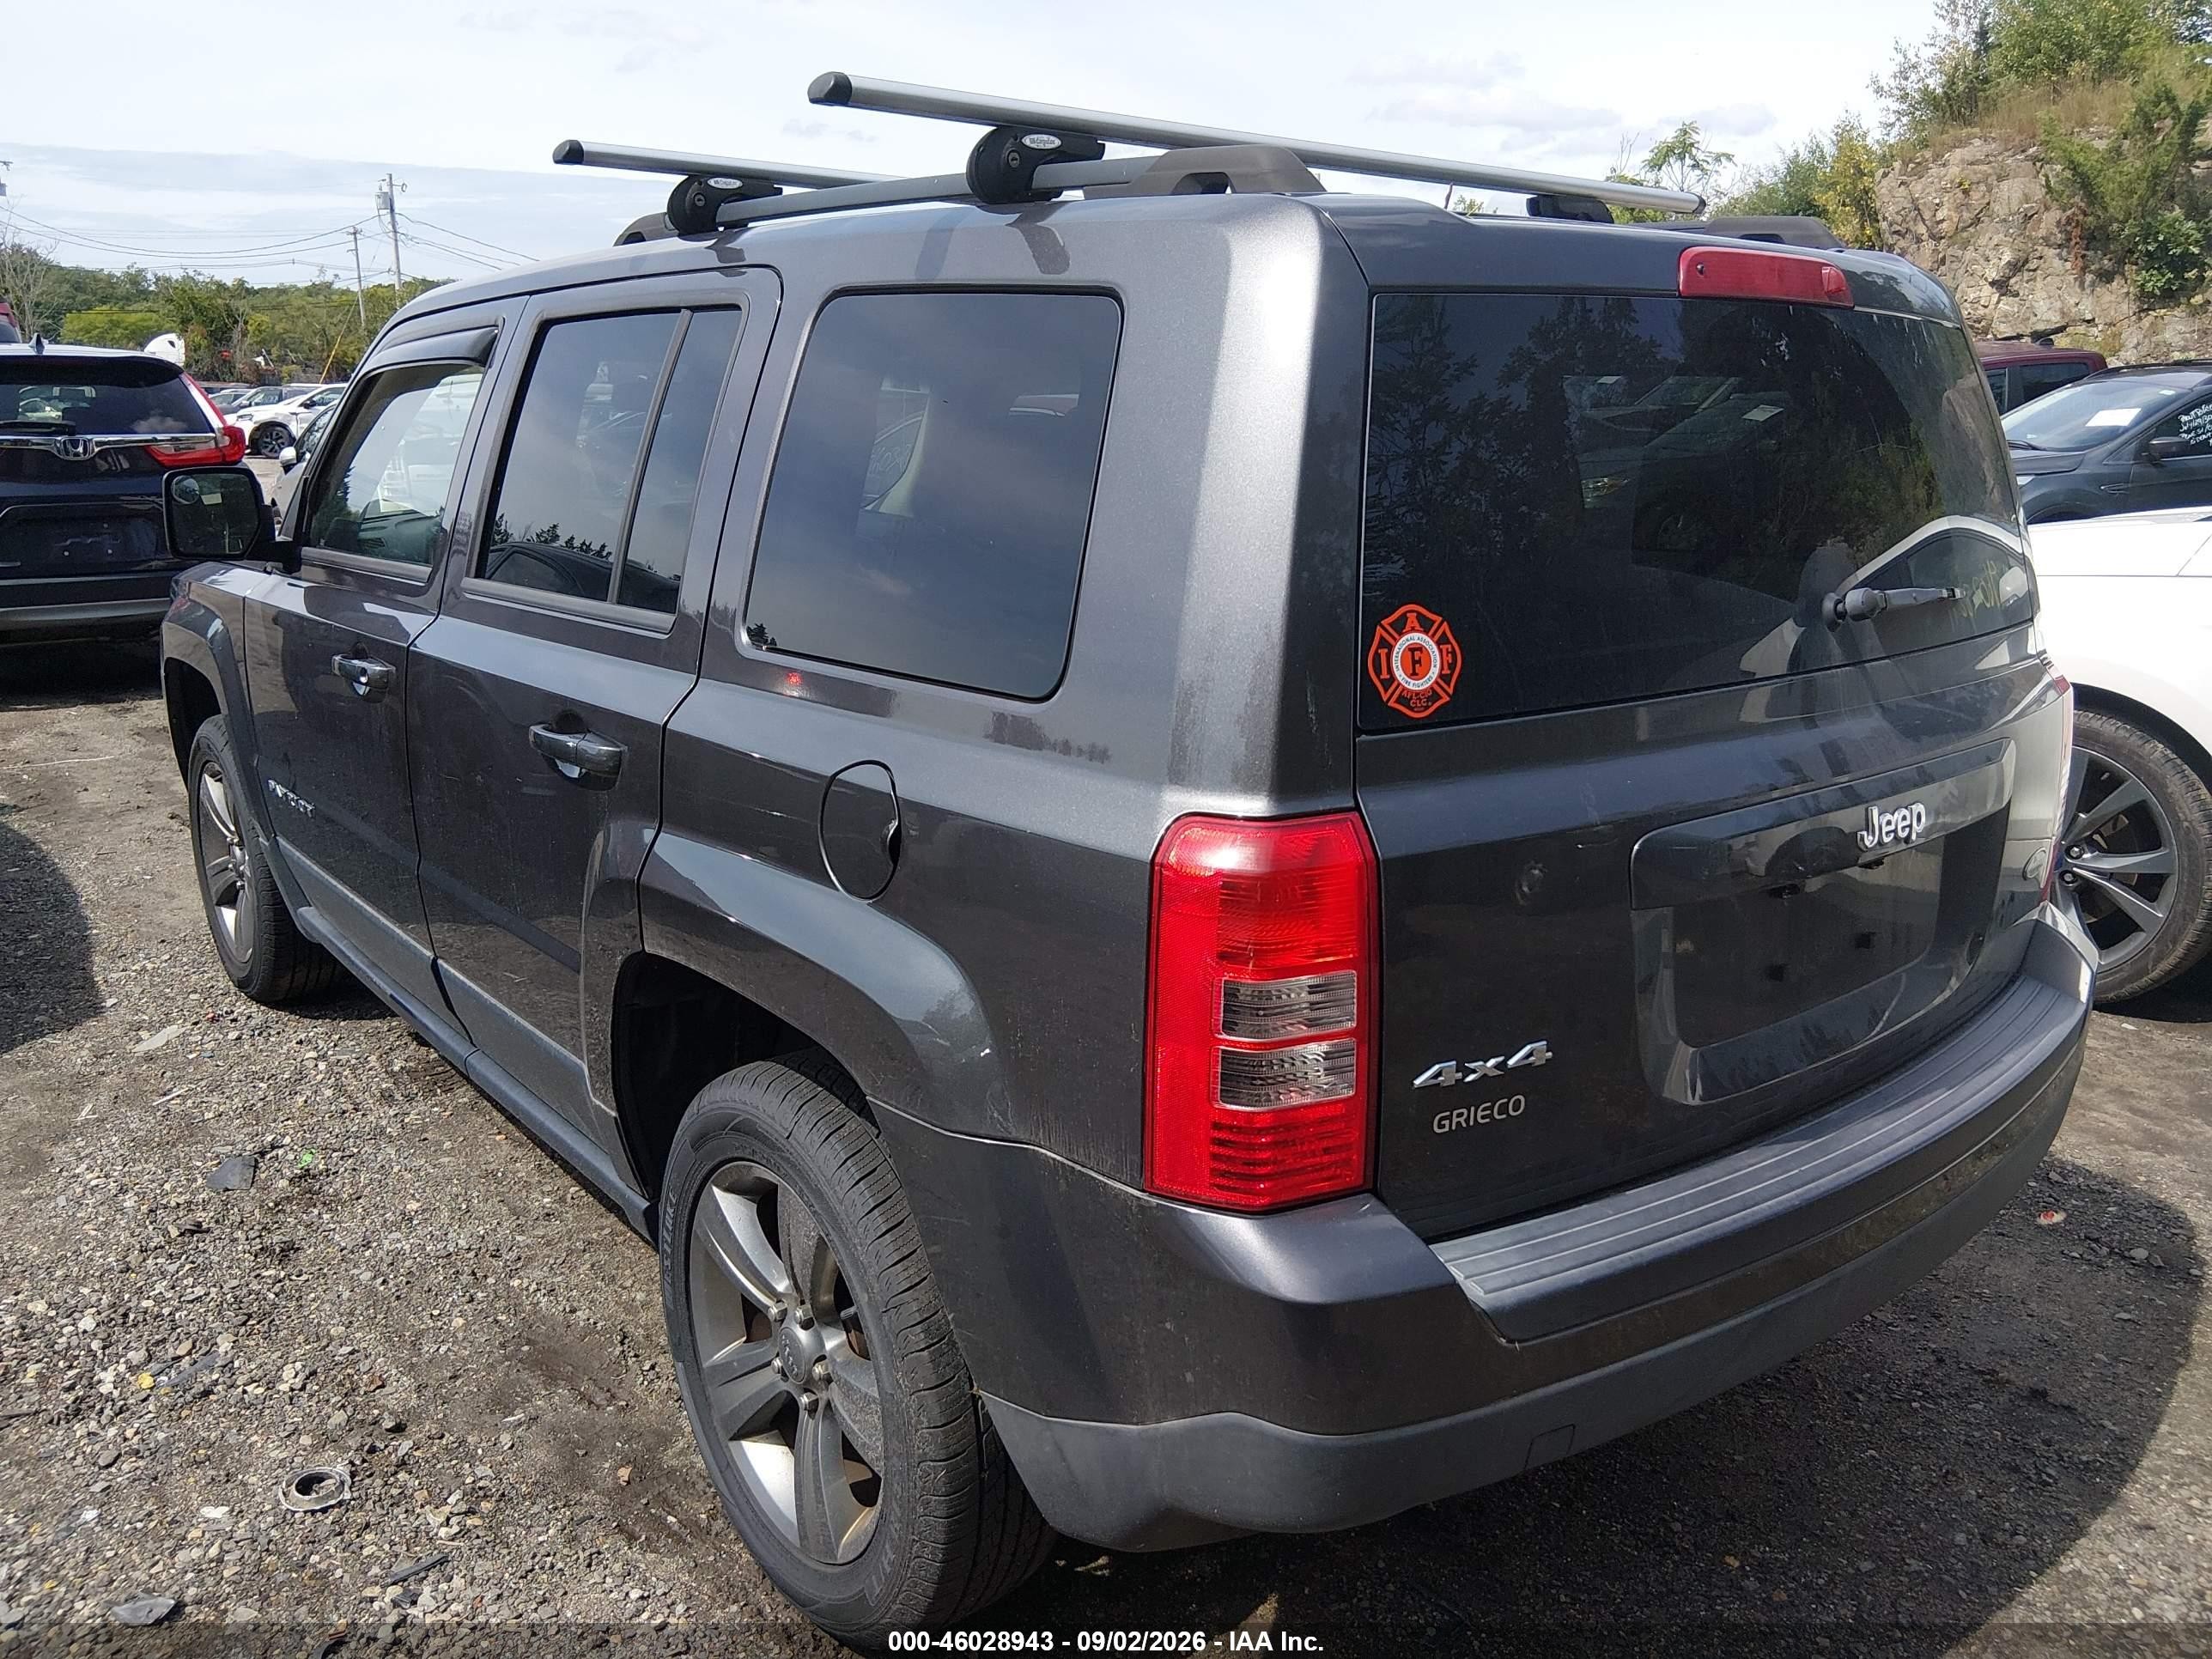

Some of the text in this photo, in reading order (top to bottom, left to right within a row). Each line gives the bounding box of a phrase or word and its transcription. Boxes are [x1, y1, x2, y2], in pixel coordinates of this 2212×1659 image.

[1402, 612, 1425, 633] A
[1394, 636, 1437, 672] INTERNATIONAL ASSOCIATION
[1407, 647, 1423, 677] F
[1440, 644, 1453, 674] F
[1412, 675, 1434, 688] FIGHTERS
[1857, 802, 1926, 850] Jeep
[1413, 1040, 1553, 1089] 4x4
[1432, 1094, 1526, 1134] GRIECO
